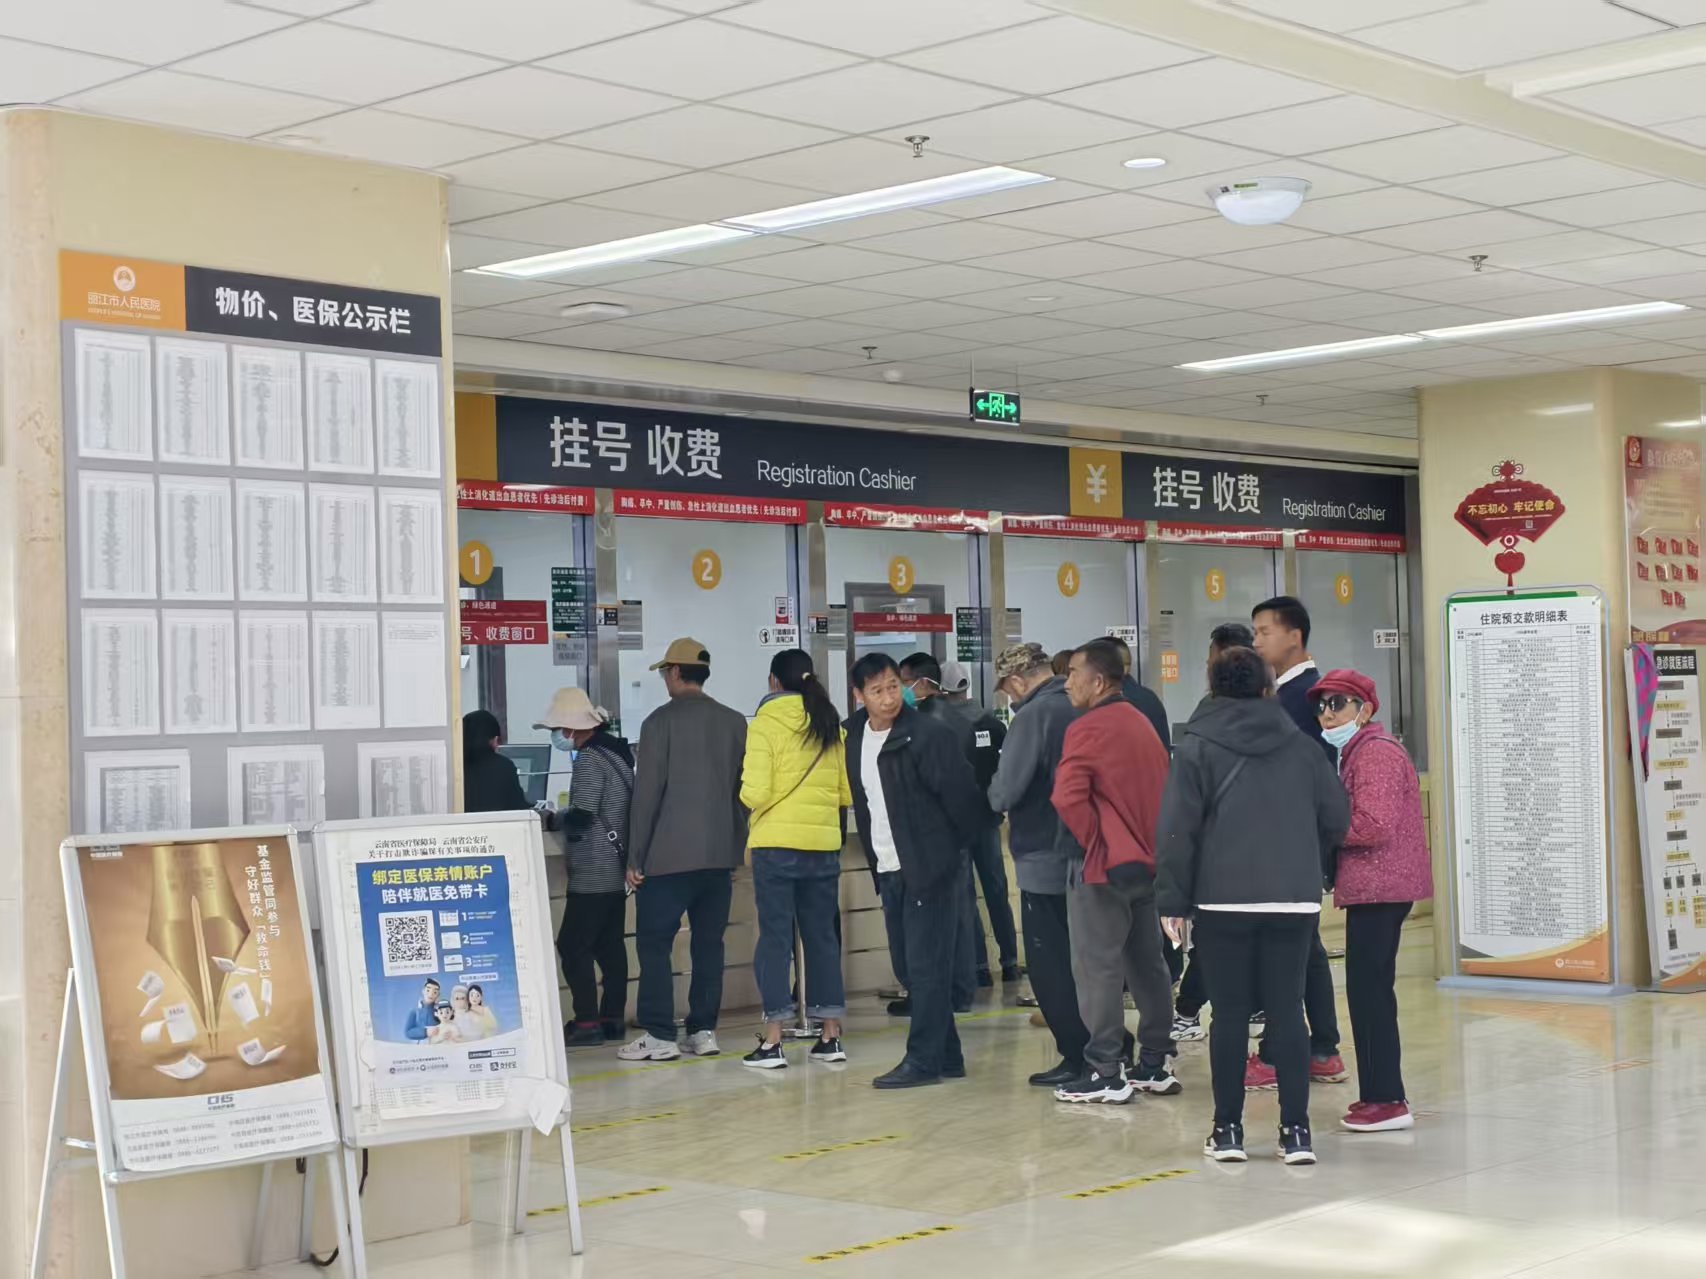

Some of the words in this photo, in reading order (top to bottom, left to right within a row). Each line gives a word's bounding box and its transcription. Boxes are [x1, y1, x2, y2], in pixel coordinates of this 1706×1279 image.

[215, 286, 412, 336] 物价、医保公示栏
[550, 416, 632, 472] 挂号
[647, 424, 723, 479] 收费
[757, 459, 855, 488] Registration
[859, 467, 917, 491] Cashier
[1153, 466, 1204, 511] 挂号
[1212, 471, 1261, 515] 收费
[1282, 497, 1346, 521] Registration
[1348, 503, 1387, 521] Cashier
[1467, 503, 1508, 516] 不忘初心
[1513, 499, 1555, 513] 牢记使命
[469, 550, 482, 576] 1
[701, 557, 714, 582] 2
[896, 563, 907, 587] 3
[1063, 571, 1074, 590] 4
[1211, 575, 1220, 594] 5
[1339, 579, 1349, 597] 6
[1480, 610, 1568, 626] 住院预交款明细表
[368, 845, 496, 859] 关于打击欺诈骗保有关事项的通告
[375, 838, 437, 849] 云南省医疗保障局
[442, 836, 488, 846] 云南省公安厅
[372, 864, 493, 885] 绑定医保亲情账户
[257, 844, 281, 937] 基金监管同参与
[381, 883, 489, 905] 陪伴就医免带卡
[462, 912, 468, 921] 1
[462, 934, 470, 944] 2
[465, 957, 473, 967] 3
